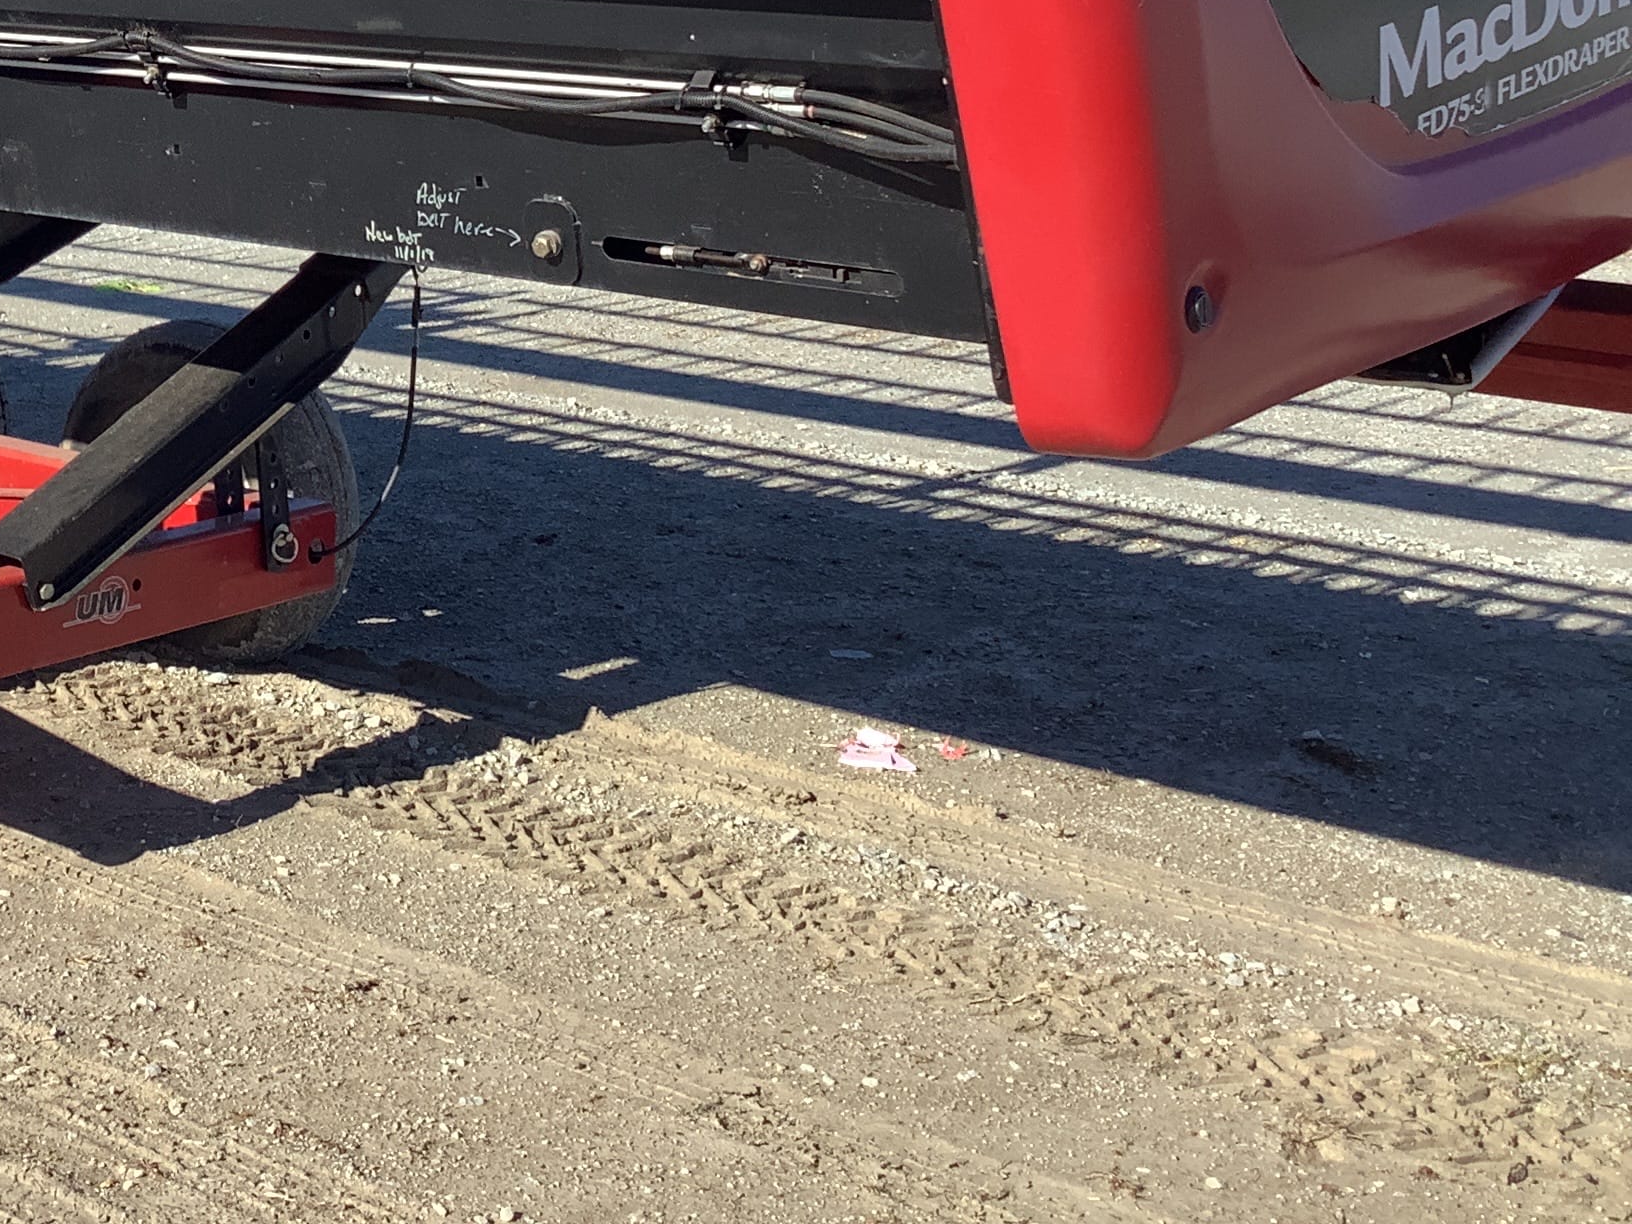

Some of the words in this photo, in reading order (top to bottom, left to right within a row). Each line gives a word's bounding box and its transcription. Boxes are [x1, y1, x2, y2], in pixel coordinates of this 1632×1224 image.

[1498, 26, 1631, 105] FLEXDRAPER
[454, 216, 494, 236] here
[76, 587, 125, 620] UM
